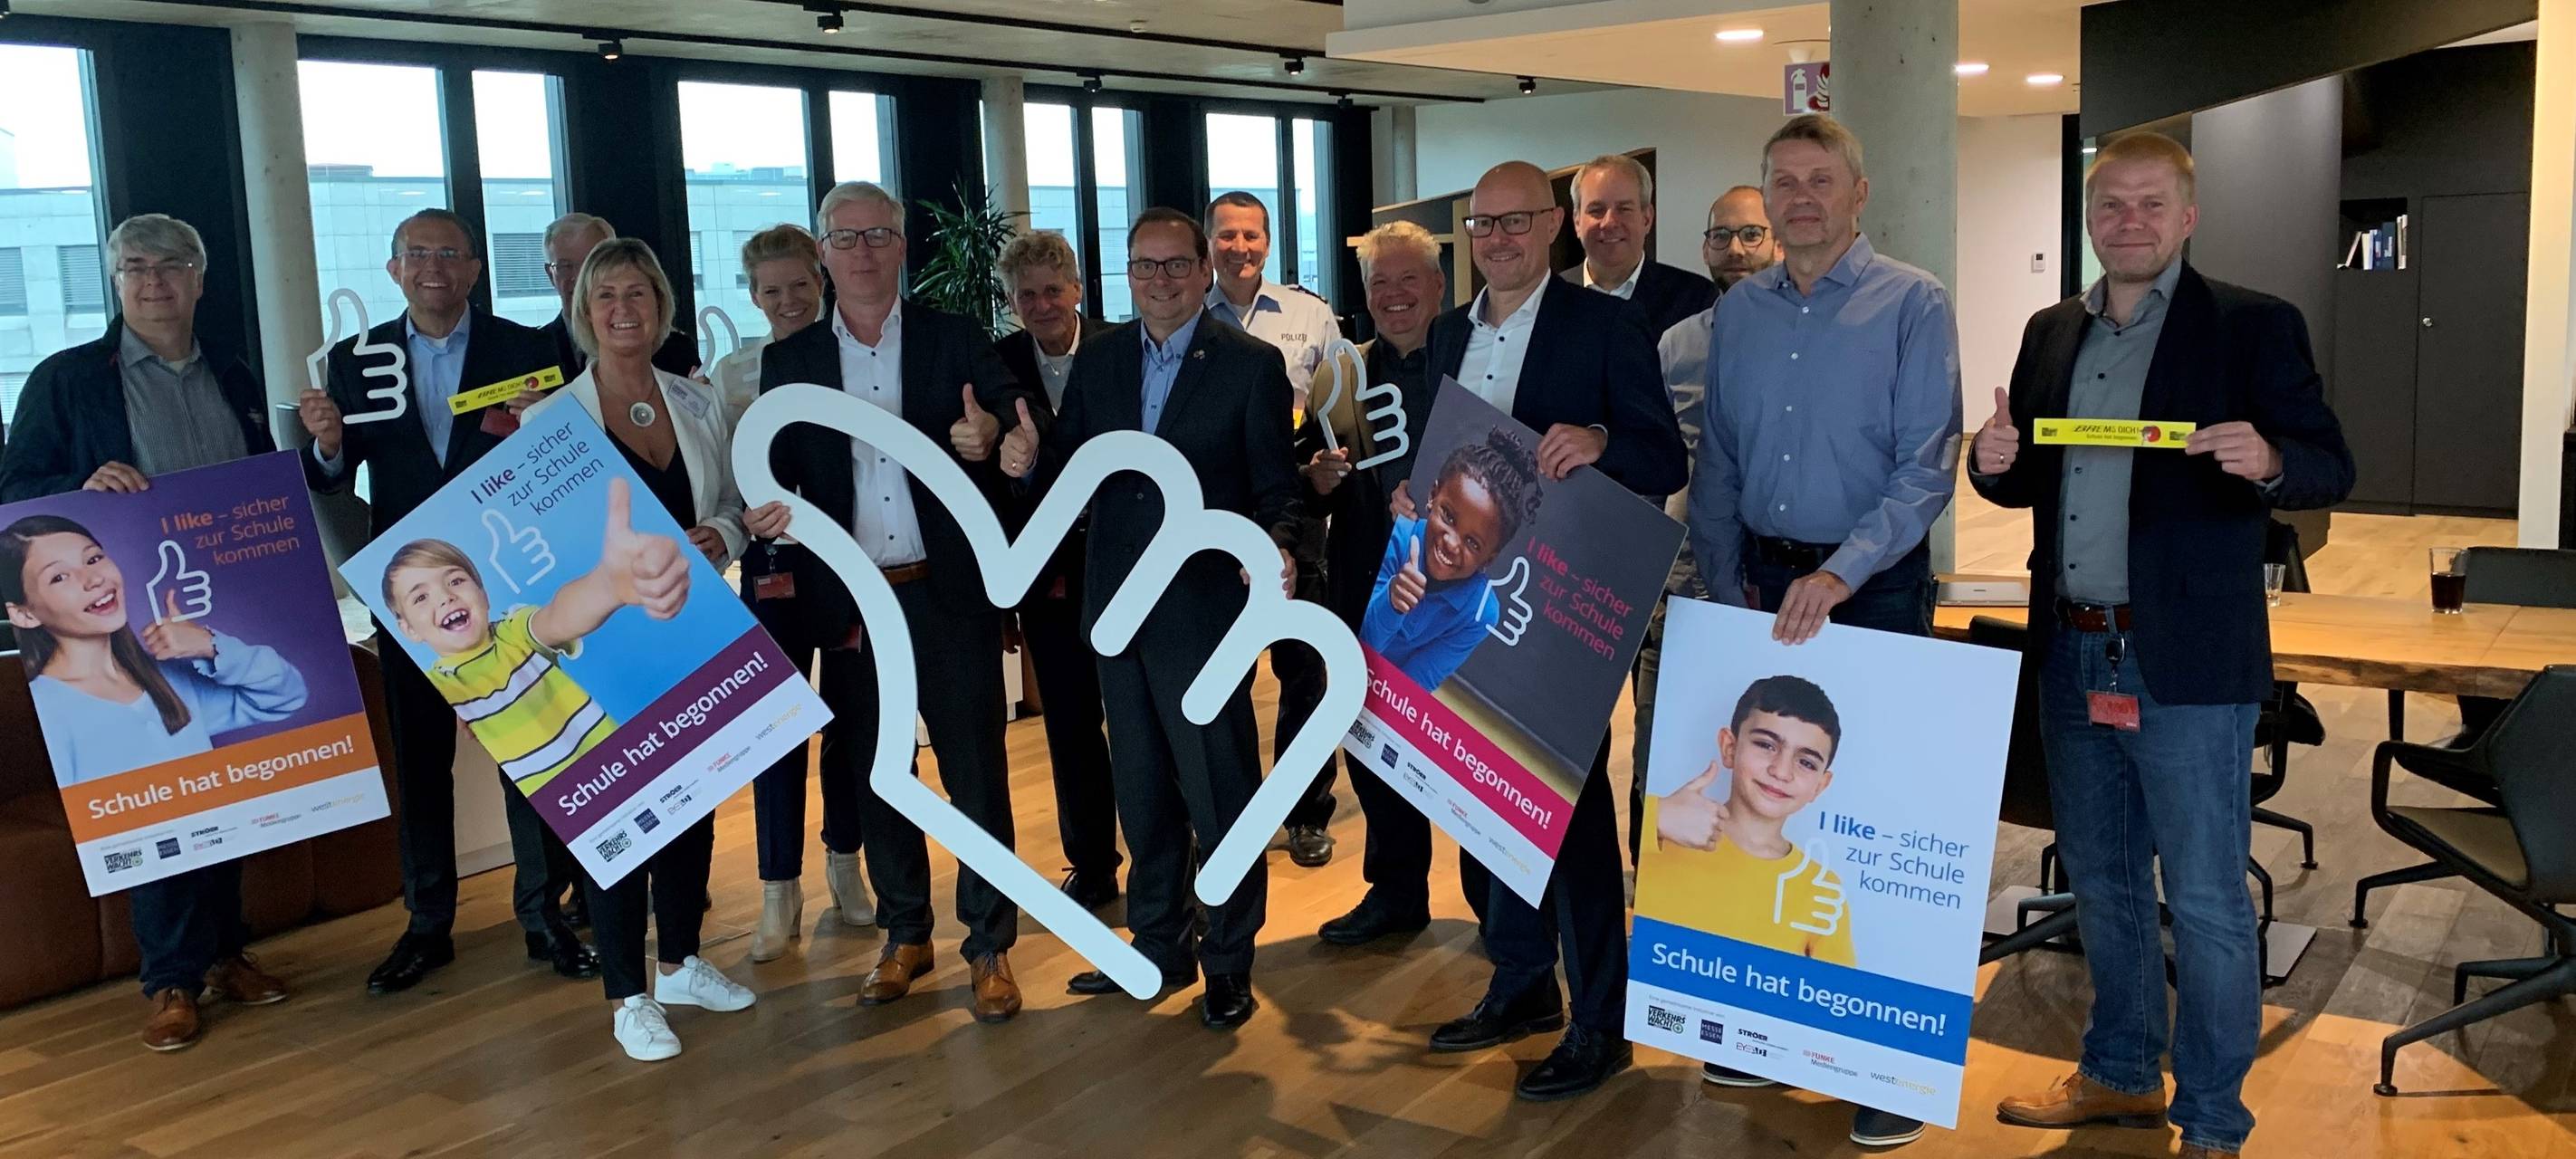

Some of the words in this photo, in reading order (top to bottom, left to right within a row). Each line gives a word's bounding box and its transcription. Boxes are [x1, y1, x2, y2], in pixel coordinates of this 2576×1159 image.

[471, 490, 484, 504] I
[480, 468, 516, 497] like
[526, 422, 573, 465] sicher
[507, 480, 534, 507] zur
[534, 441, 589, 485] Schule
[530, 457, 605, 516] kommen
[160, 517, 169, 535] I
[174, 512, 214, 532] like
[232, 496, 289, 520] sicher
[195, 531, 225, 549] zur
[231, 515, 295, 541] Schule
[213, 536, 301, 565] kommen
[1527, 536, 1536, 553] I
[1537, 543, 1568, 576] like
[1582, 578, 1634, 618] sicher
[1540, 575, 1568, 599] zur
[1569, 593, 1623, 640] Schule
[1543, 599, 1615, 661] kommen
[558, 761, 627, 817] Schule
[623, 731, 665, 766] hat
[658, 651, 770, 739] begonnen!
[88, 783, 173, 819] Schule
[179, 770, 223, 796] hat
[225, 734, 354, 781] begonnen!
[1420, 713, 1453, 751] hat
[1452, 738, 1552, 829] begonnen!
[1819, 811, 1825, 830] I
[1833, 814, 1876, 840] like
[1899, 830, 1970, 858] sicher
[1845, 847, 1882, 867] zur
[1889, 852, 1965, 884] Schule
[1859, 870, 1961, 909] kommen
[1648, 1006, 1686, 1024] VERKEHRS
[1652, 942, 1738, 983] Schule
[1746, 964, 1790, 997] hat
[1797, 978, 1947, 1036] begonnen!
[1647, 1015, 1672, 1029] WACHT
